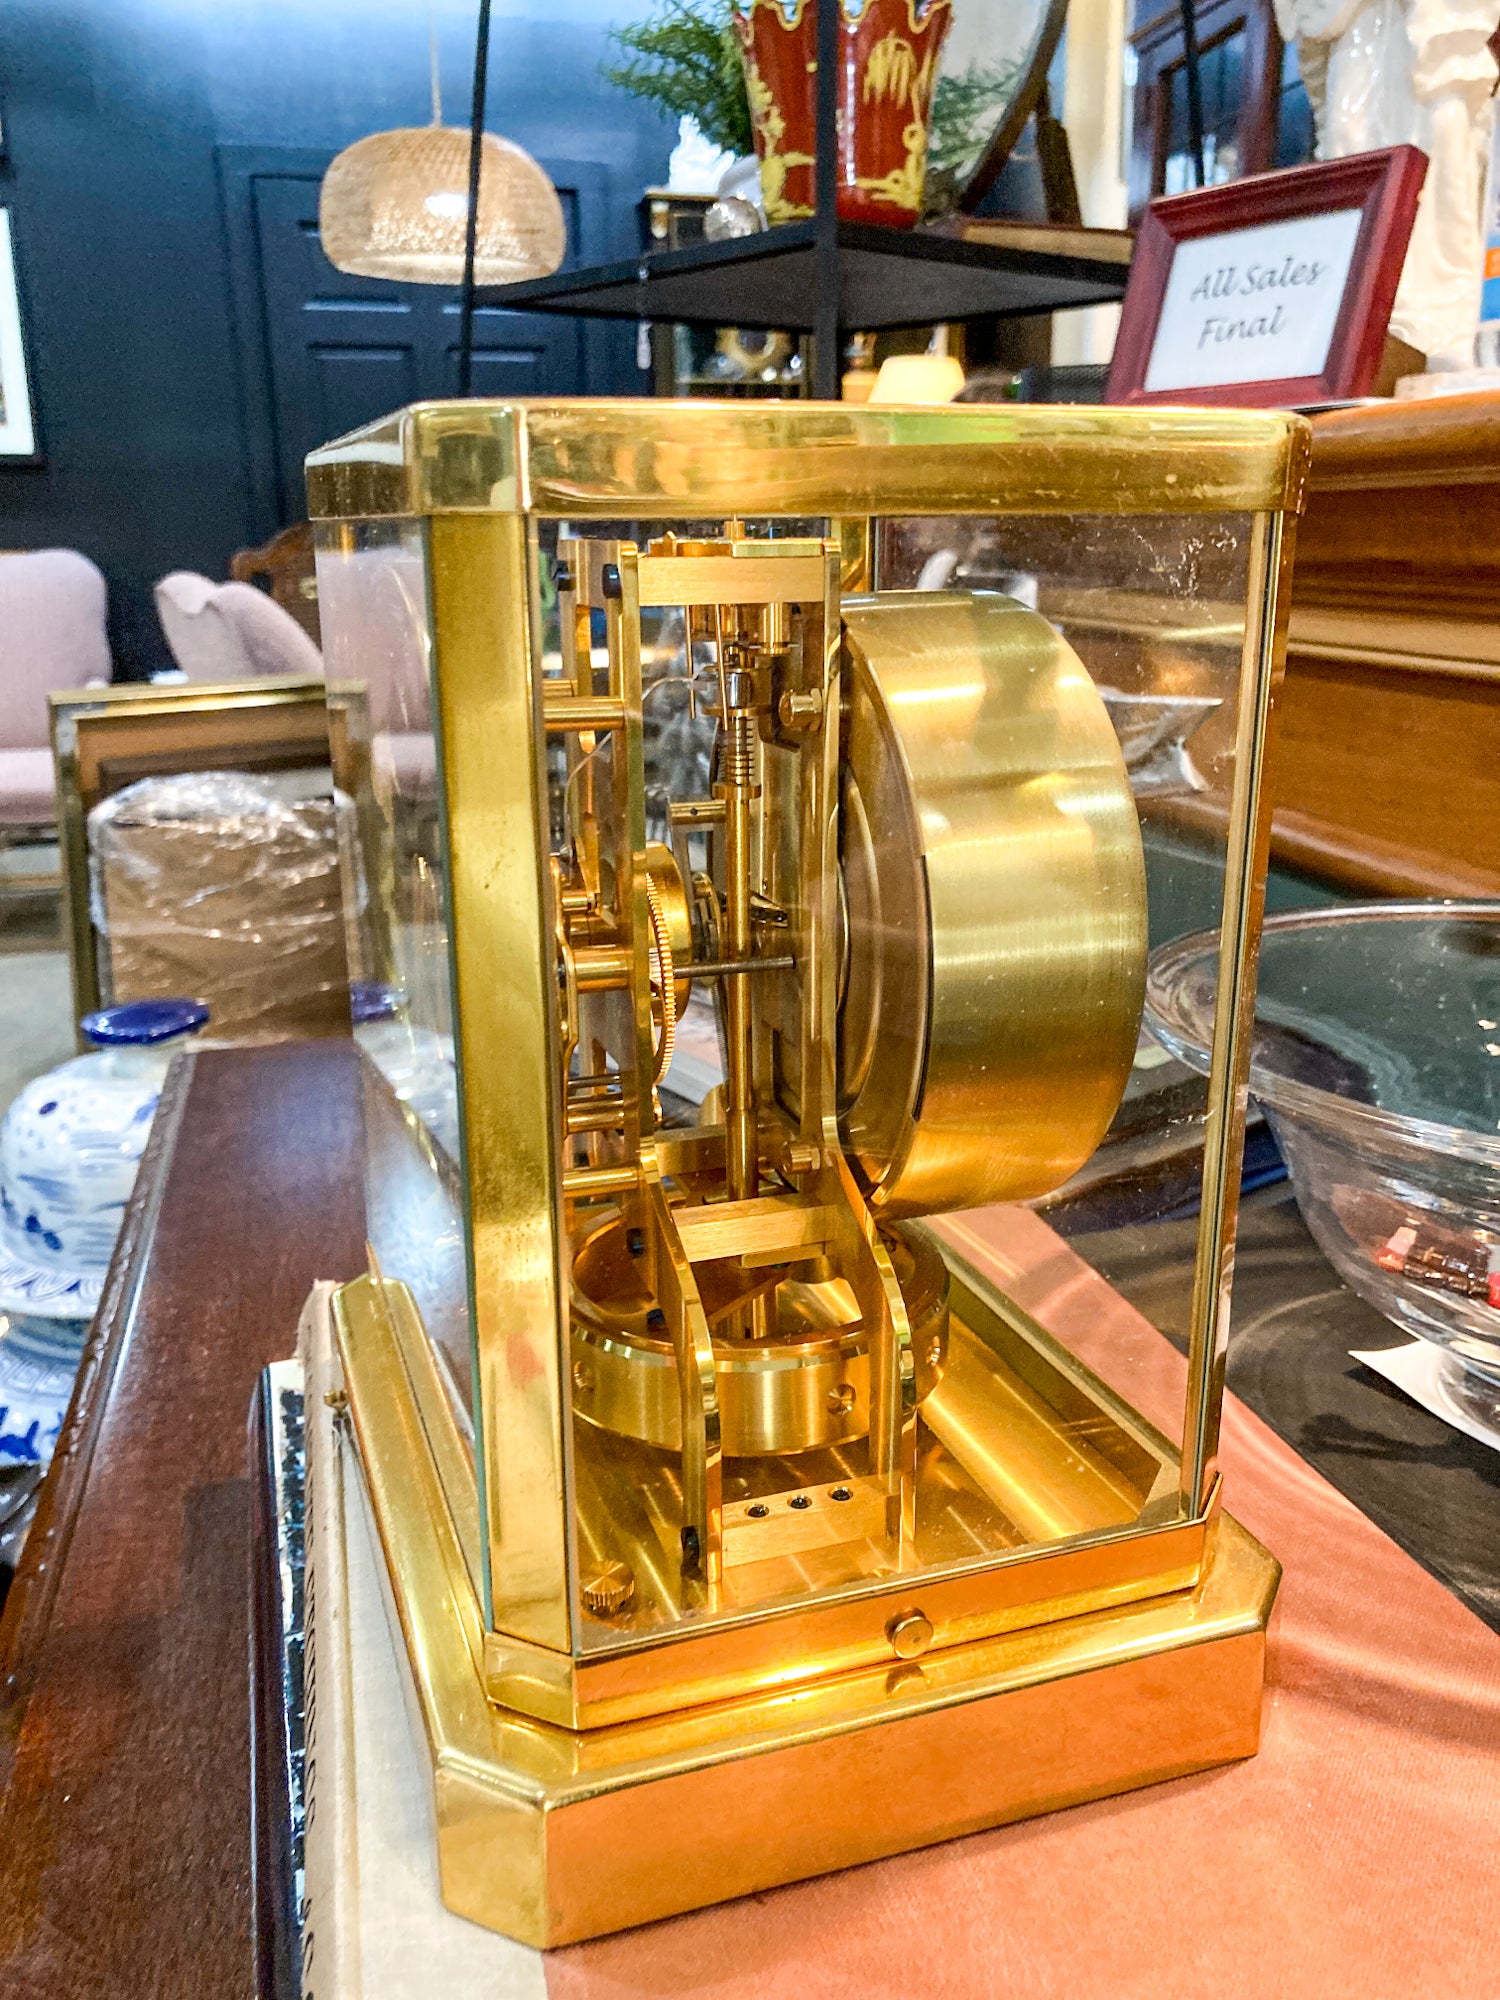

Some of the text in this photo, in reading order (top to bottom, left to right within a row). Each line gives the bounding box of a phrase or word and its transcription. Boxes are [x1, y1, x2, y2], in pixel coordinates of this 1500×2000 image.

[1190, 256, 1325, 302] All Sales
[1197, 304, 1287, 350] Final
